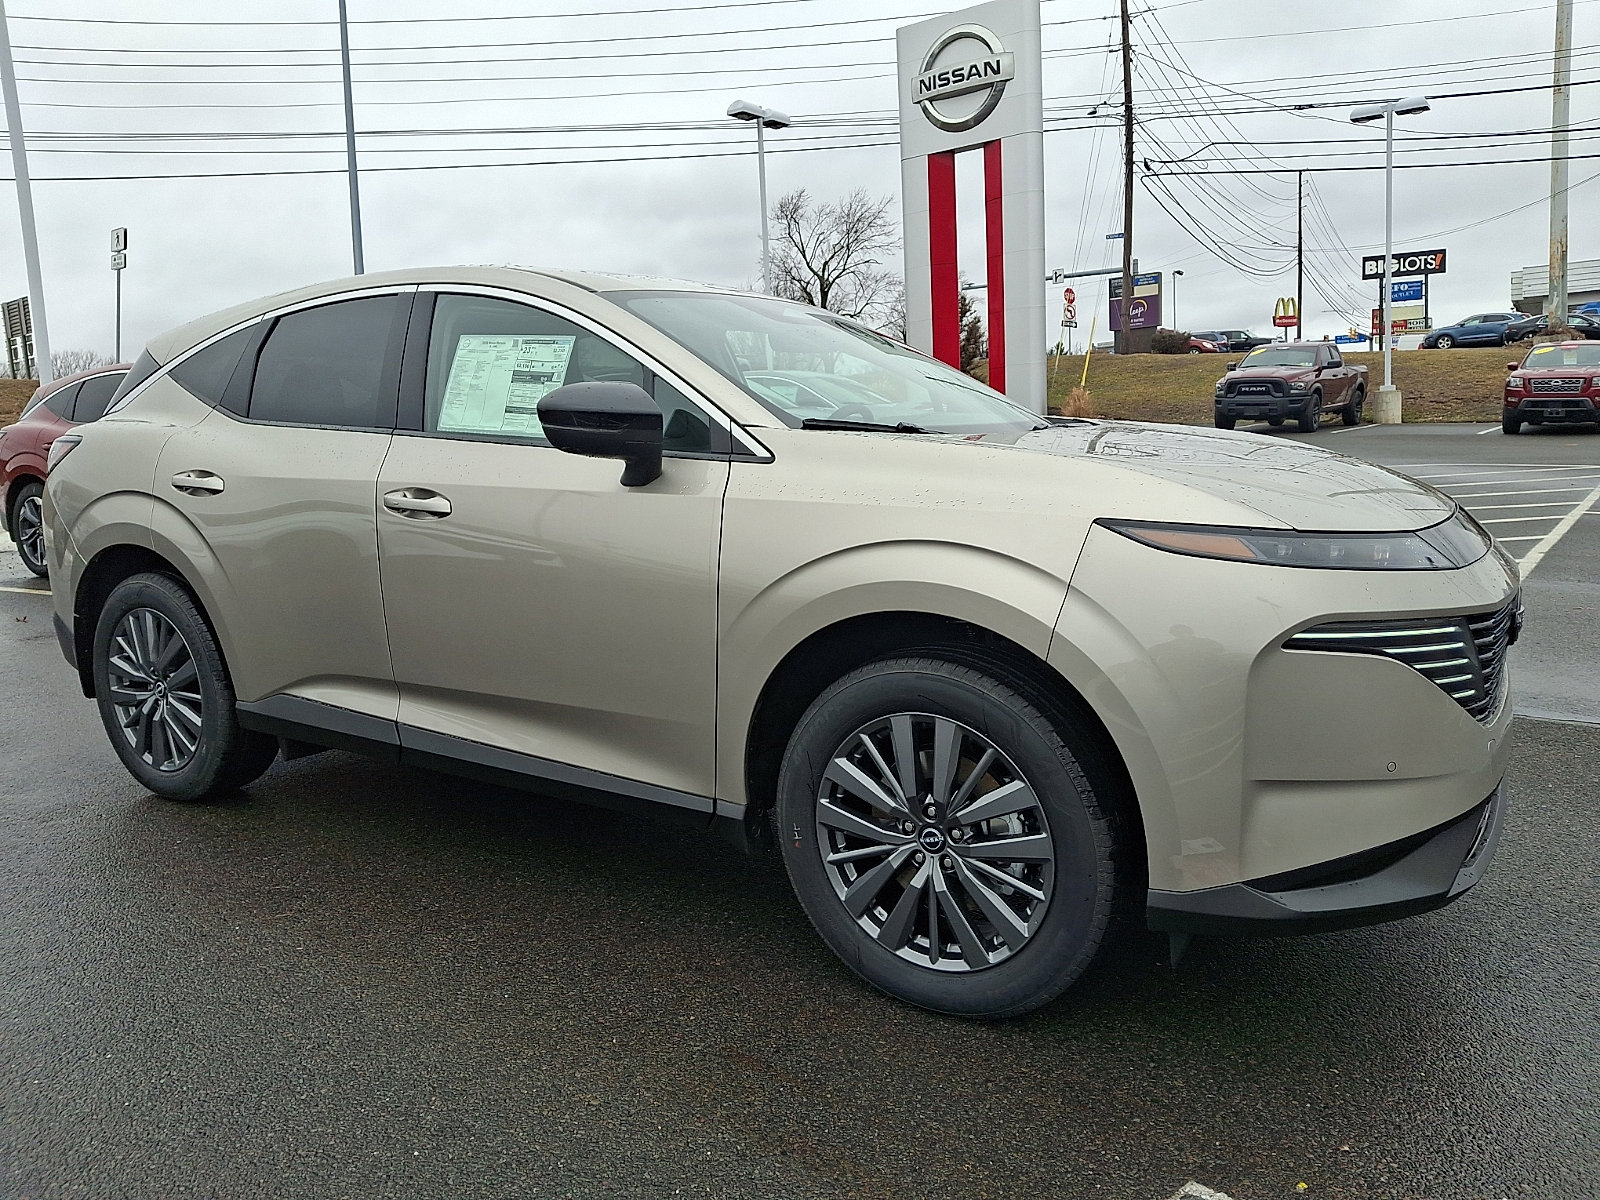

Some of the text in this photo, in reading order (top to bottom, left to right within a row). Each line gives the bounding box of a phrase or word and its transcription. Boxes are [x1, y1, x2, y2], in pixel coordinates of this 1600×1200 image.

[919, 59, 1001, 94] NISSAN
[1365, 254, 1443, 275] BIG LOTS!
[1130, 304, 1144, 317] leep
